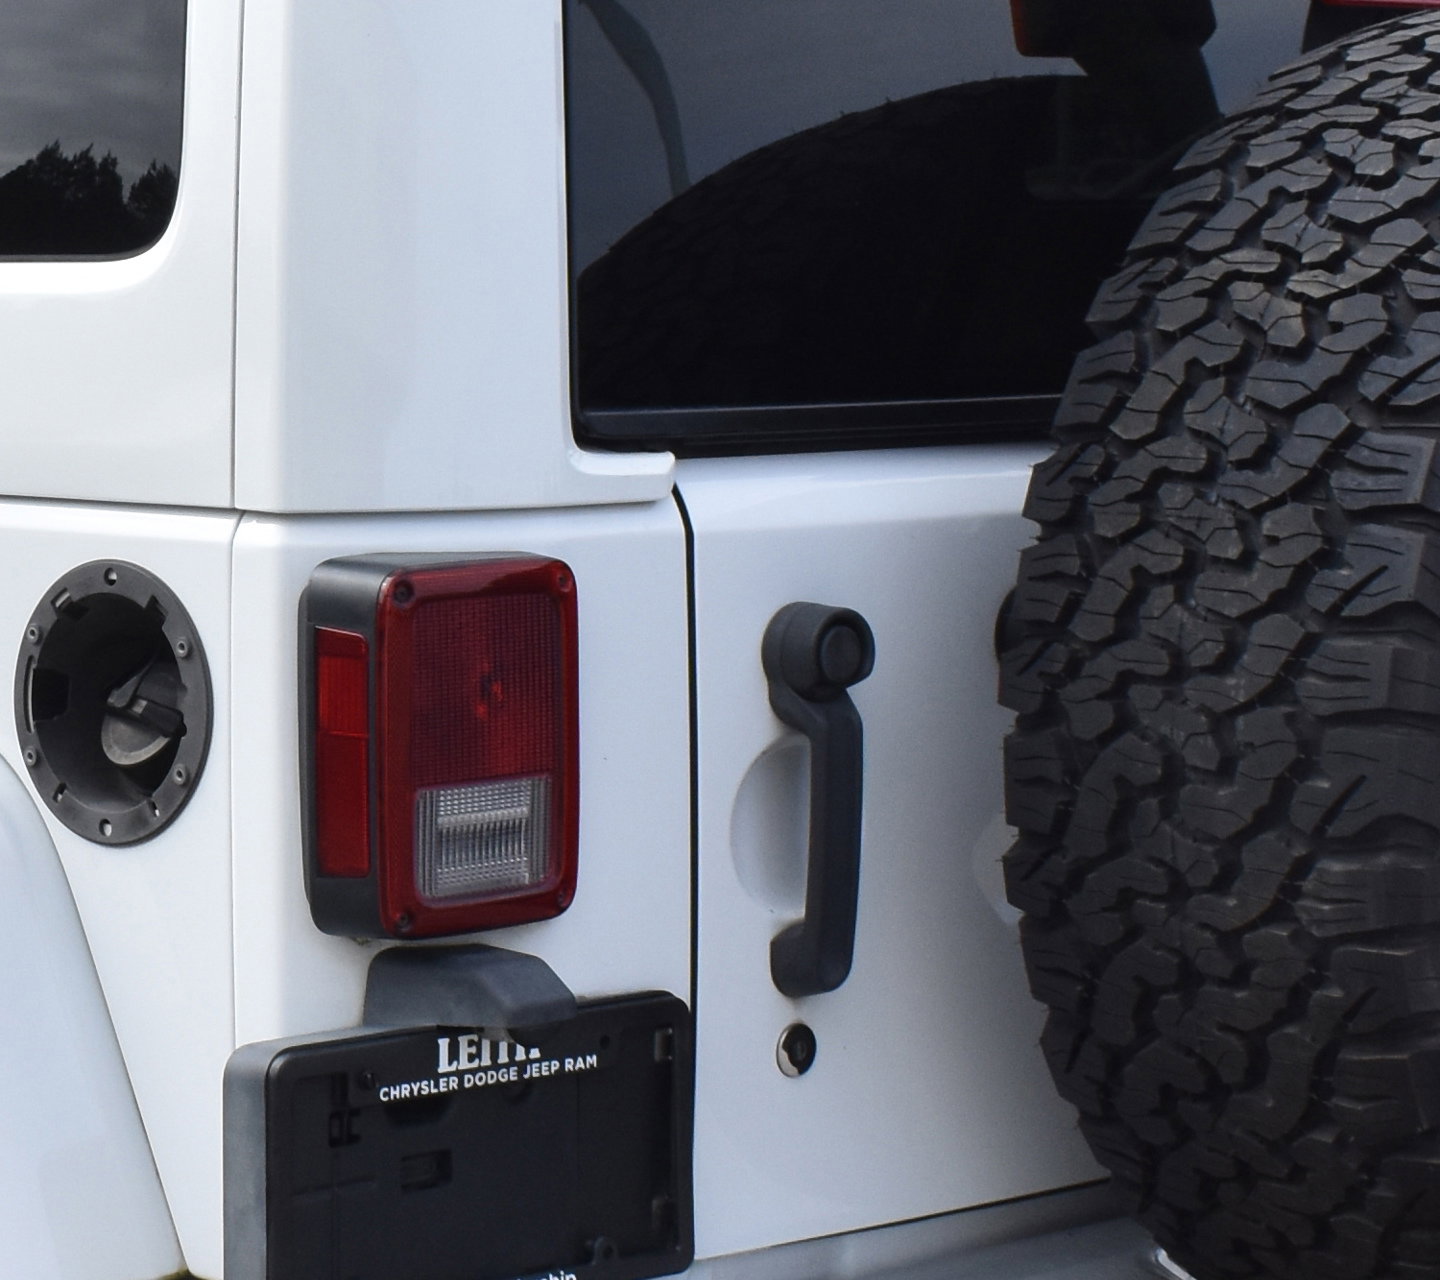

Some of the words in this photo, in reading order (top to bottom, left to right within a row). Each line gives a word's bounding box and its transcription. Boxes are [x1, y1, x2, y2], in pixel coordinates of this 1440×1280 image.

[379, 1076, 459, 1102] CHRYSLER
[463, 1066, 519, 1089] DODGE
[523, 1060, 560, 1080] JEEP
[564, 1054, 597, 1072] RAM
